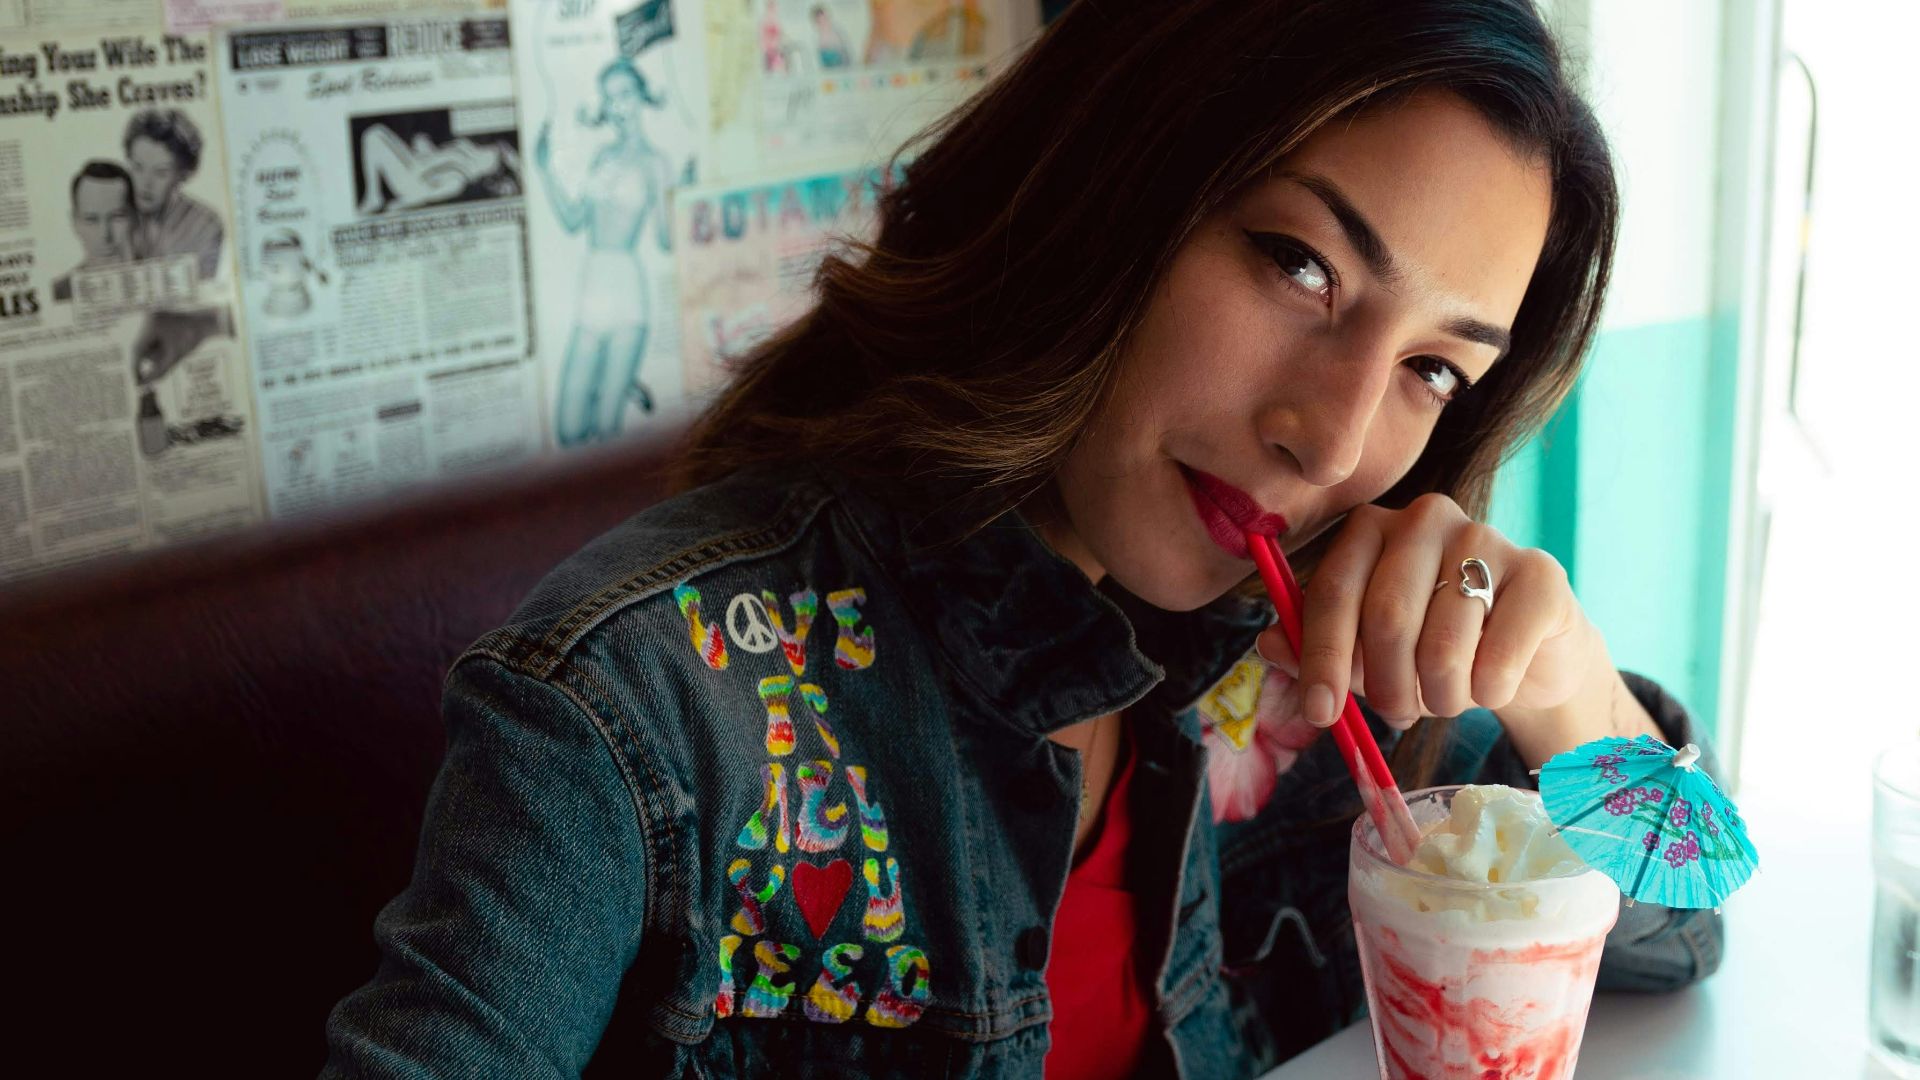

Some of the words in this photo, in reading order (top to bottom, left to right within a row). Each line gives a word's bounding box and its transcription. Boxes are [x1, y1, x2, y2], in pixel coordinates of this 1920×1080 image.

[42, 41, 97, 71] Your
[101, 36, 157, 67] Wife
[162, 33, 206, 64] The
[67, 79, 110, 110] She
[117, 70, 207, 107] Craves?
